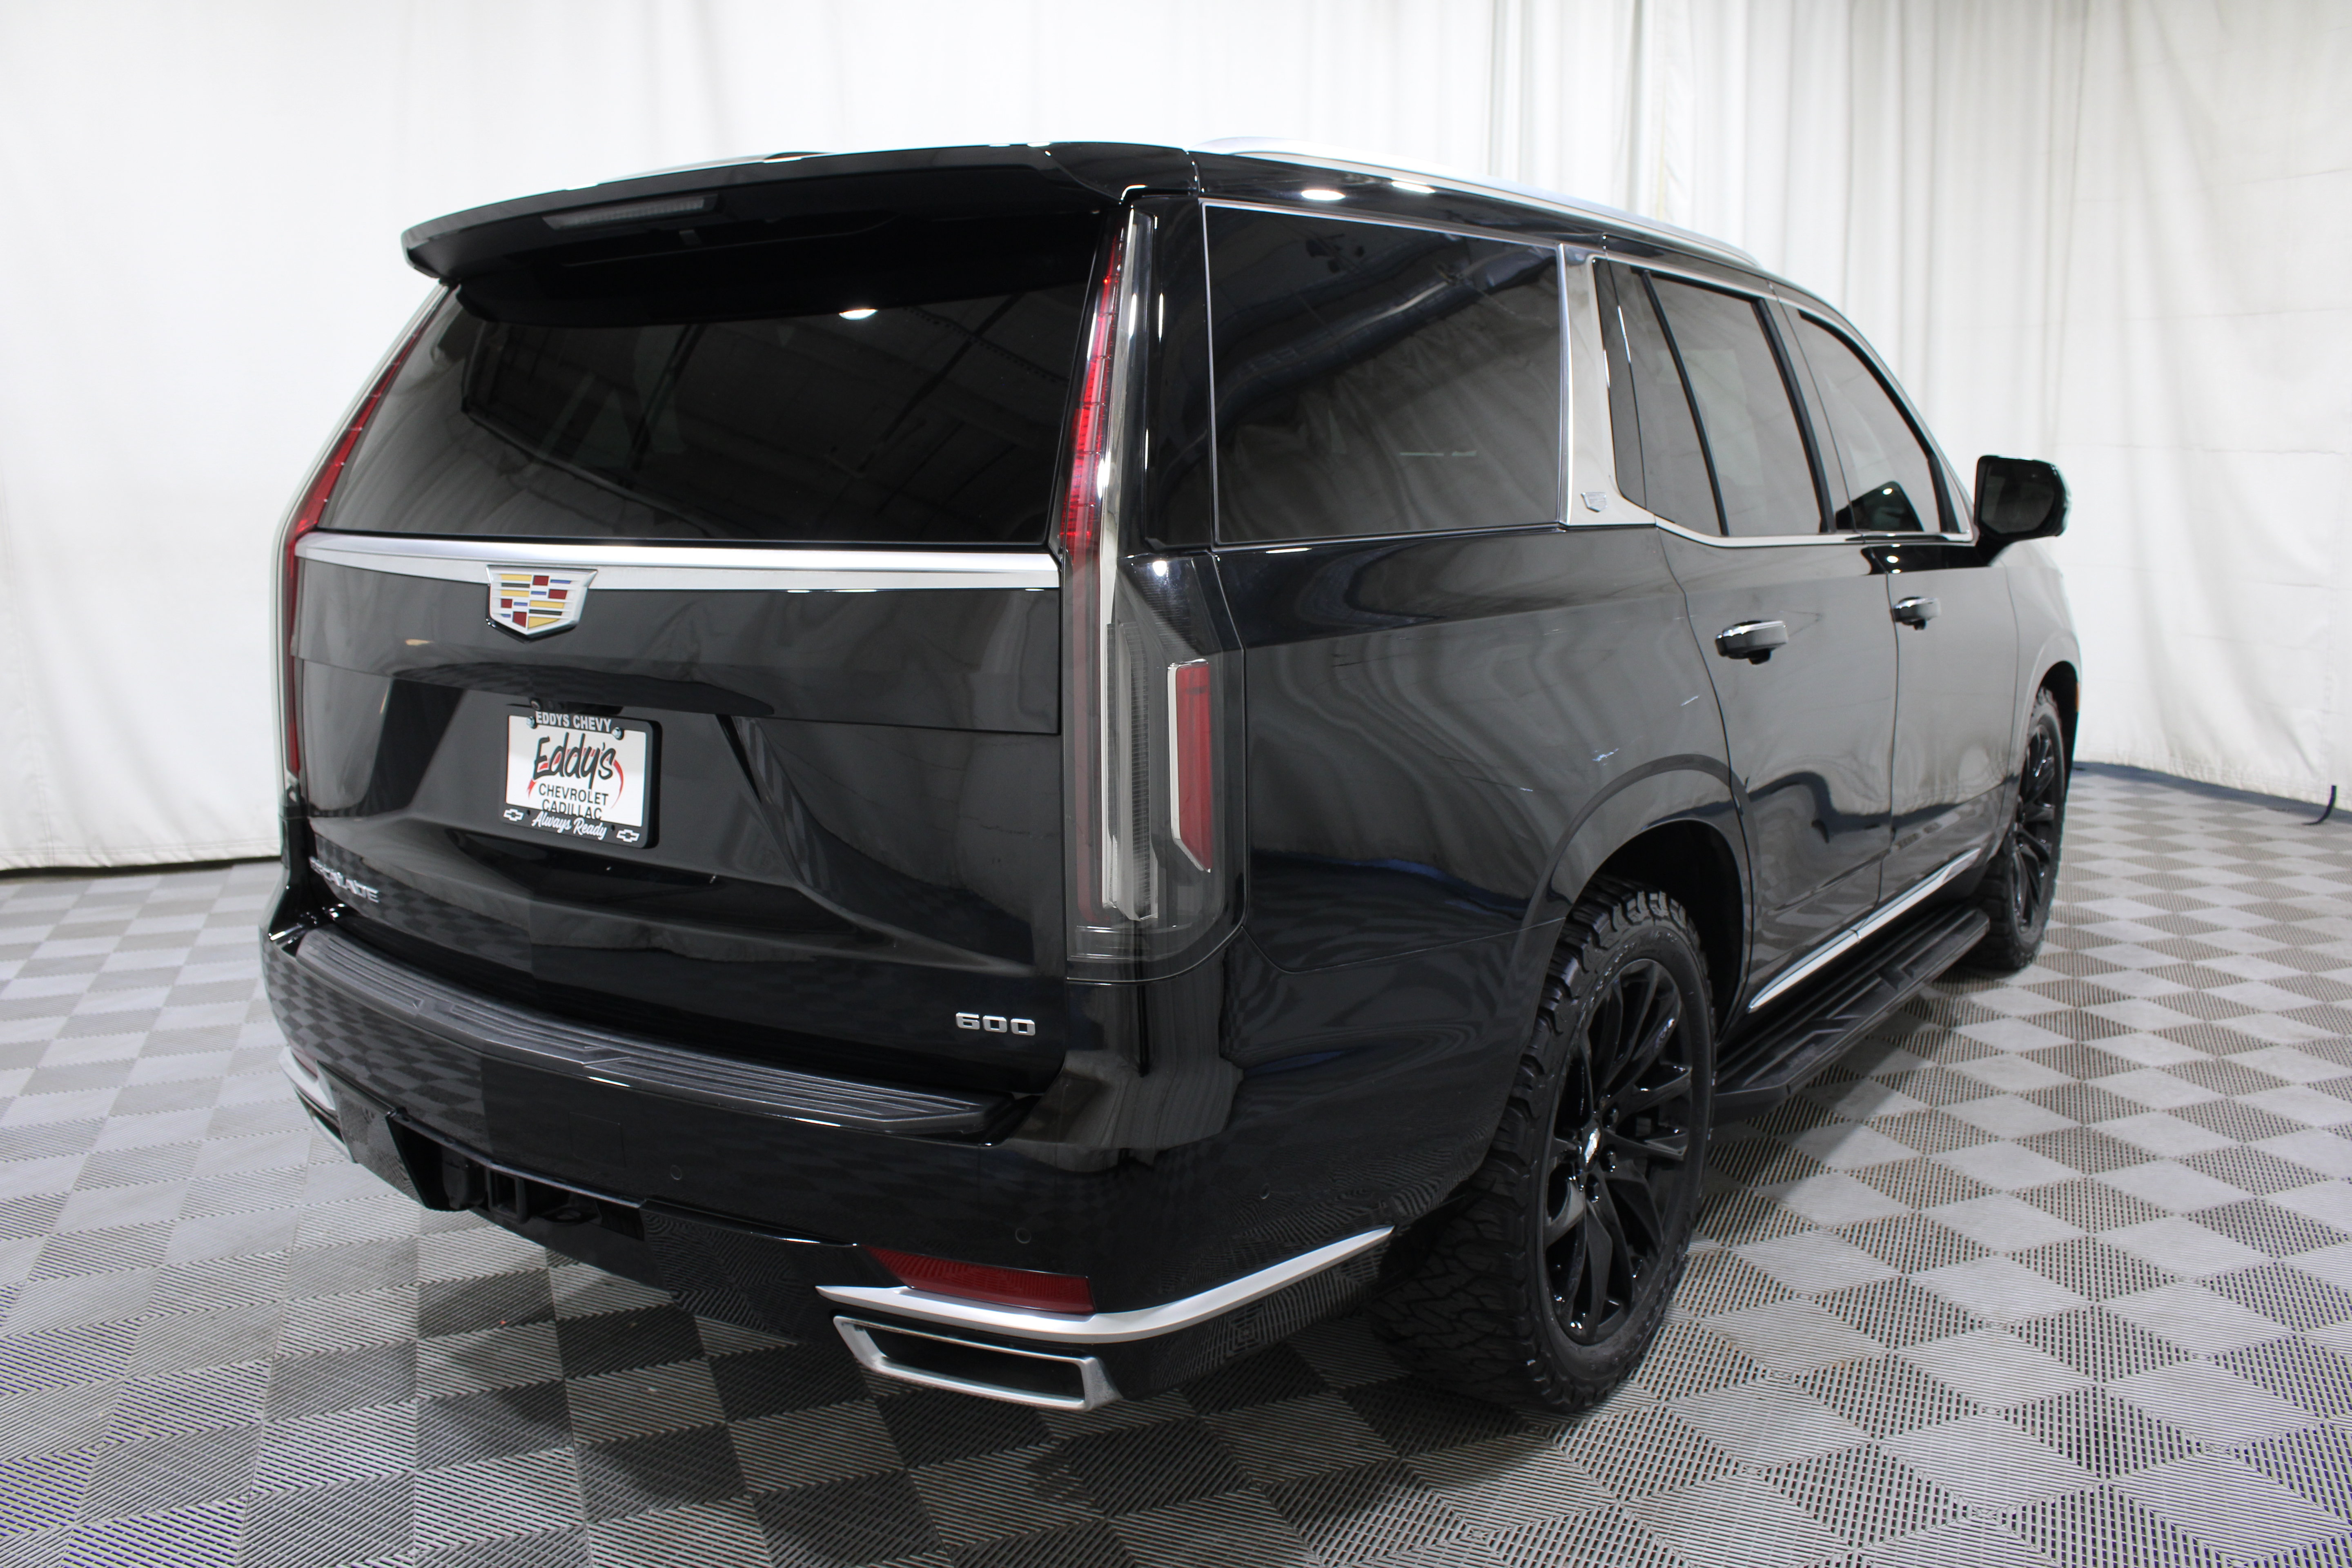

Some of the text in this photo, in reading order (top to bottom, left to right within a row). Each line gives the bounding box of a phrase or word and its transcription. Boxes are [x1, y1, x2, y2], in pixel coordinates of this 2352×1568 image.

[535, 711, 612, 732] EDDYS CHEVY
[532, 732, 616, 789] Eddy's
[539, 784, 608, 805] CHEVROLET
[542, 799, 602, 819] CADILLAC
[532, 811, 607, 840] Always Ready
[956, 1012, 1036, 1036] 600
